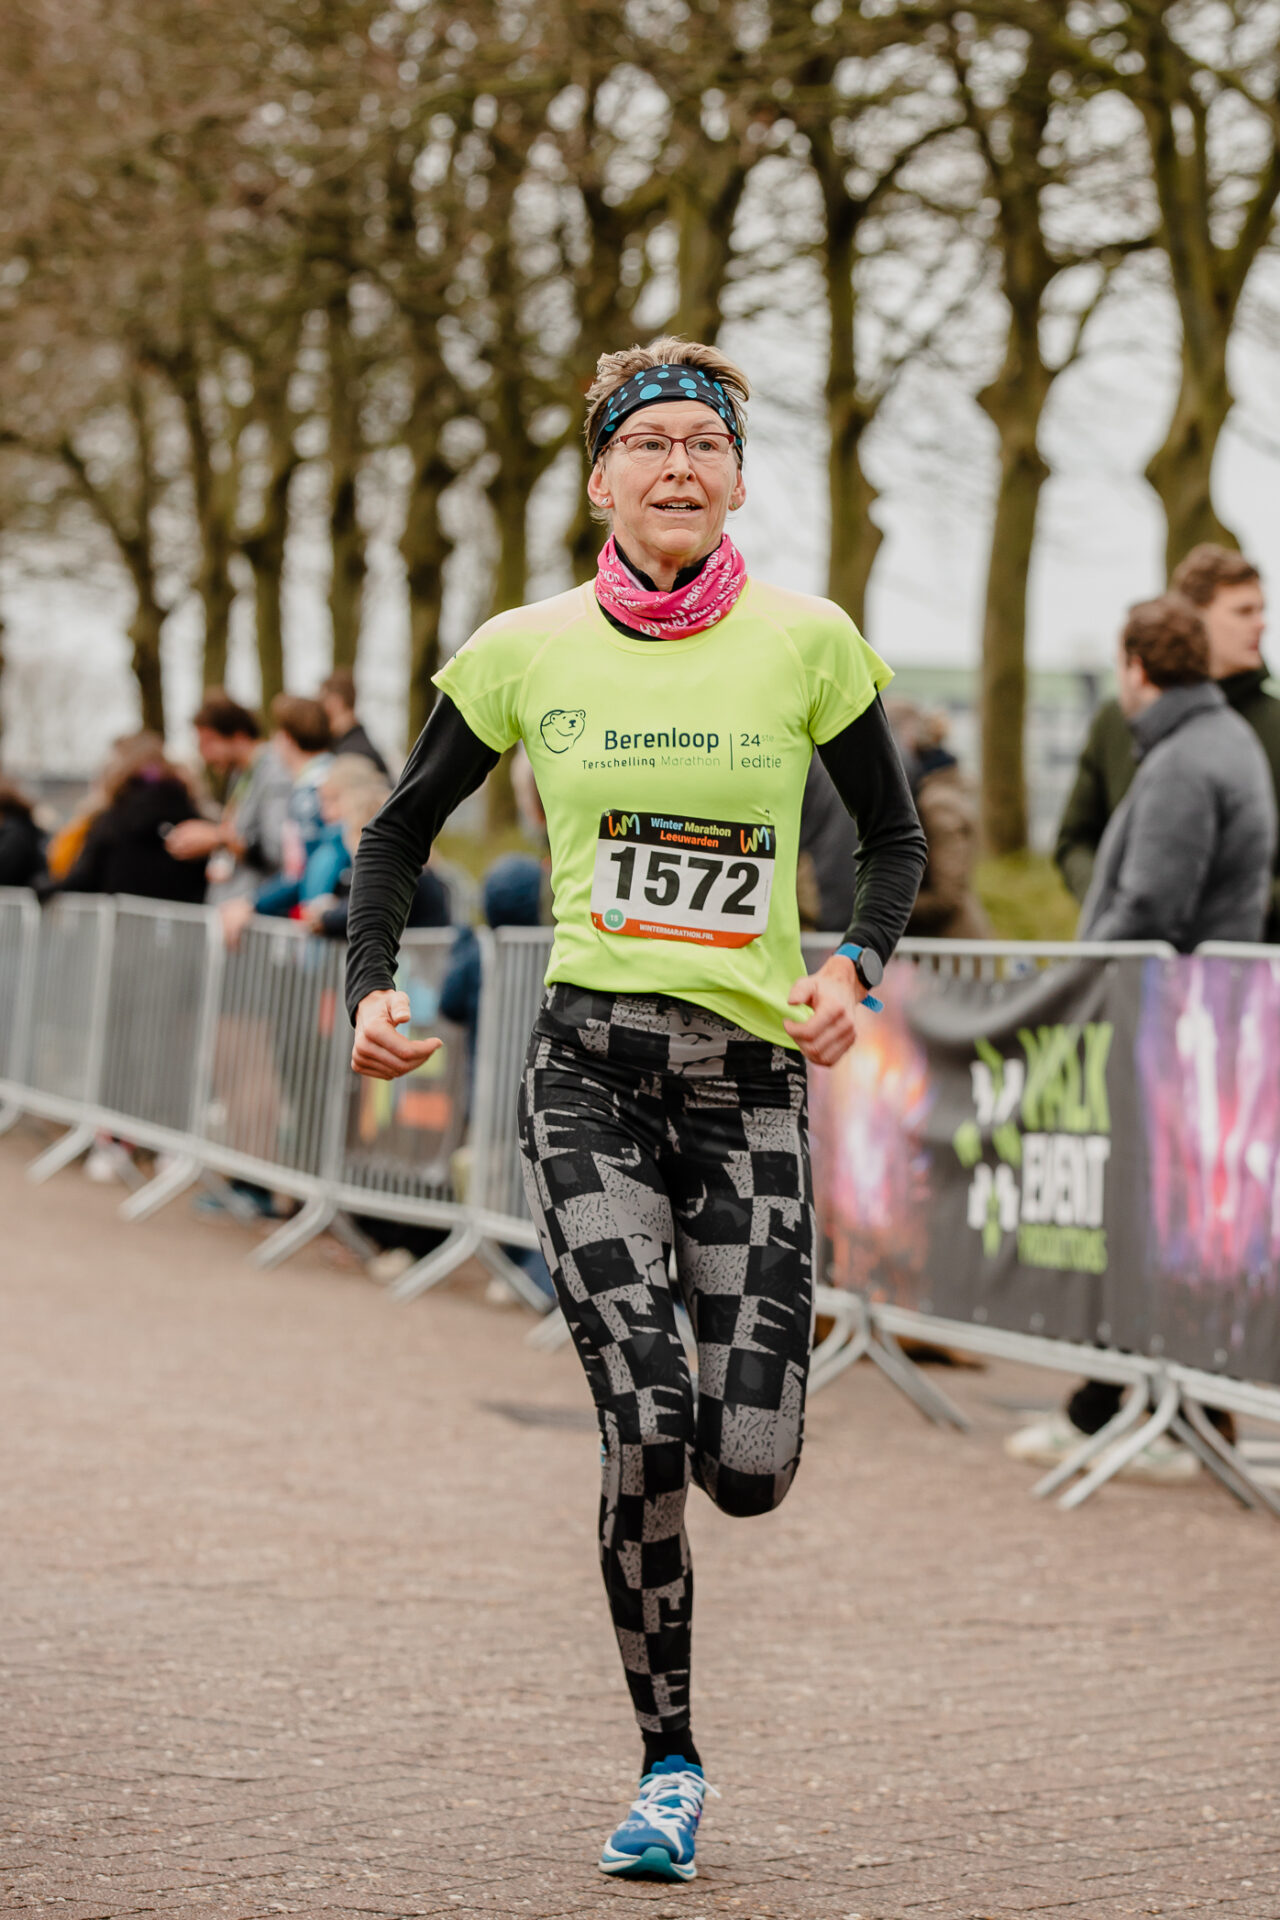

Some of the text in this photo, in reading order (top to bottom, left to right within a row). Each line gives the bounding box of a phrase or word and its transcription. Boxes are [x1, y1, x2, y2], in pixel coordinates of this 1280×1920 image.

[605, 728, 719, 753] Berenloop
[583, 755, 721, 769] Terschelling Marathon
[741, 754, 782, 768] editie
[650, 817, 732, 837] Winter Marathon
[660, 830, 719, 848] Leeuwarden
[610, 846, 760, 916] 1572
[639, 923, 714, 941] WINTERMARATHON.FRL
